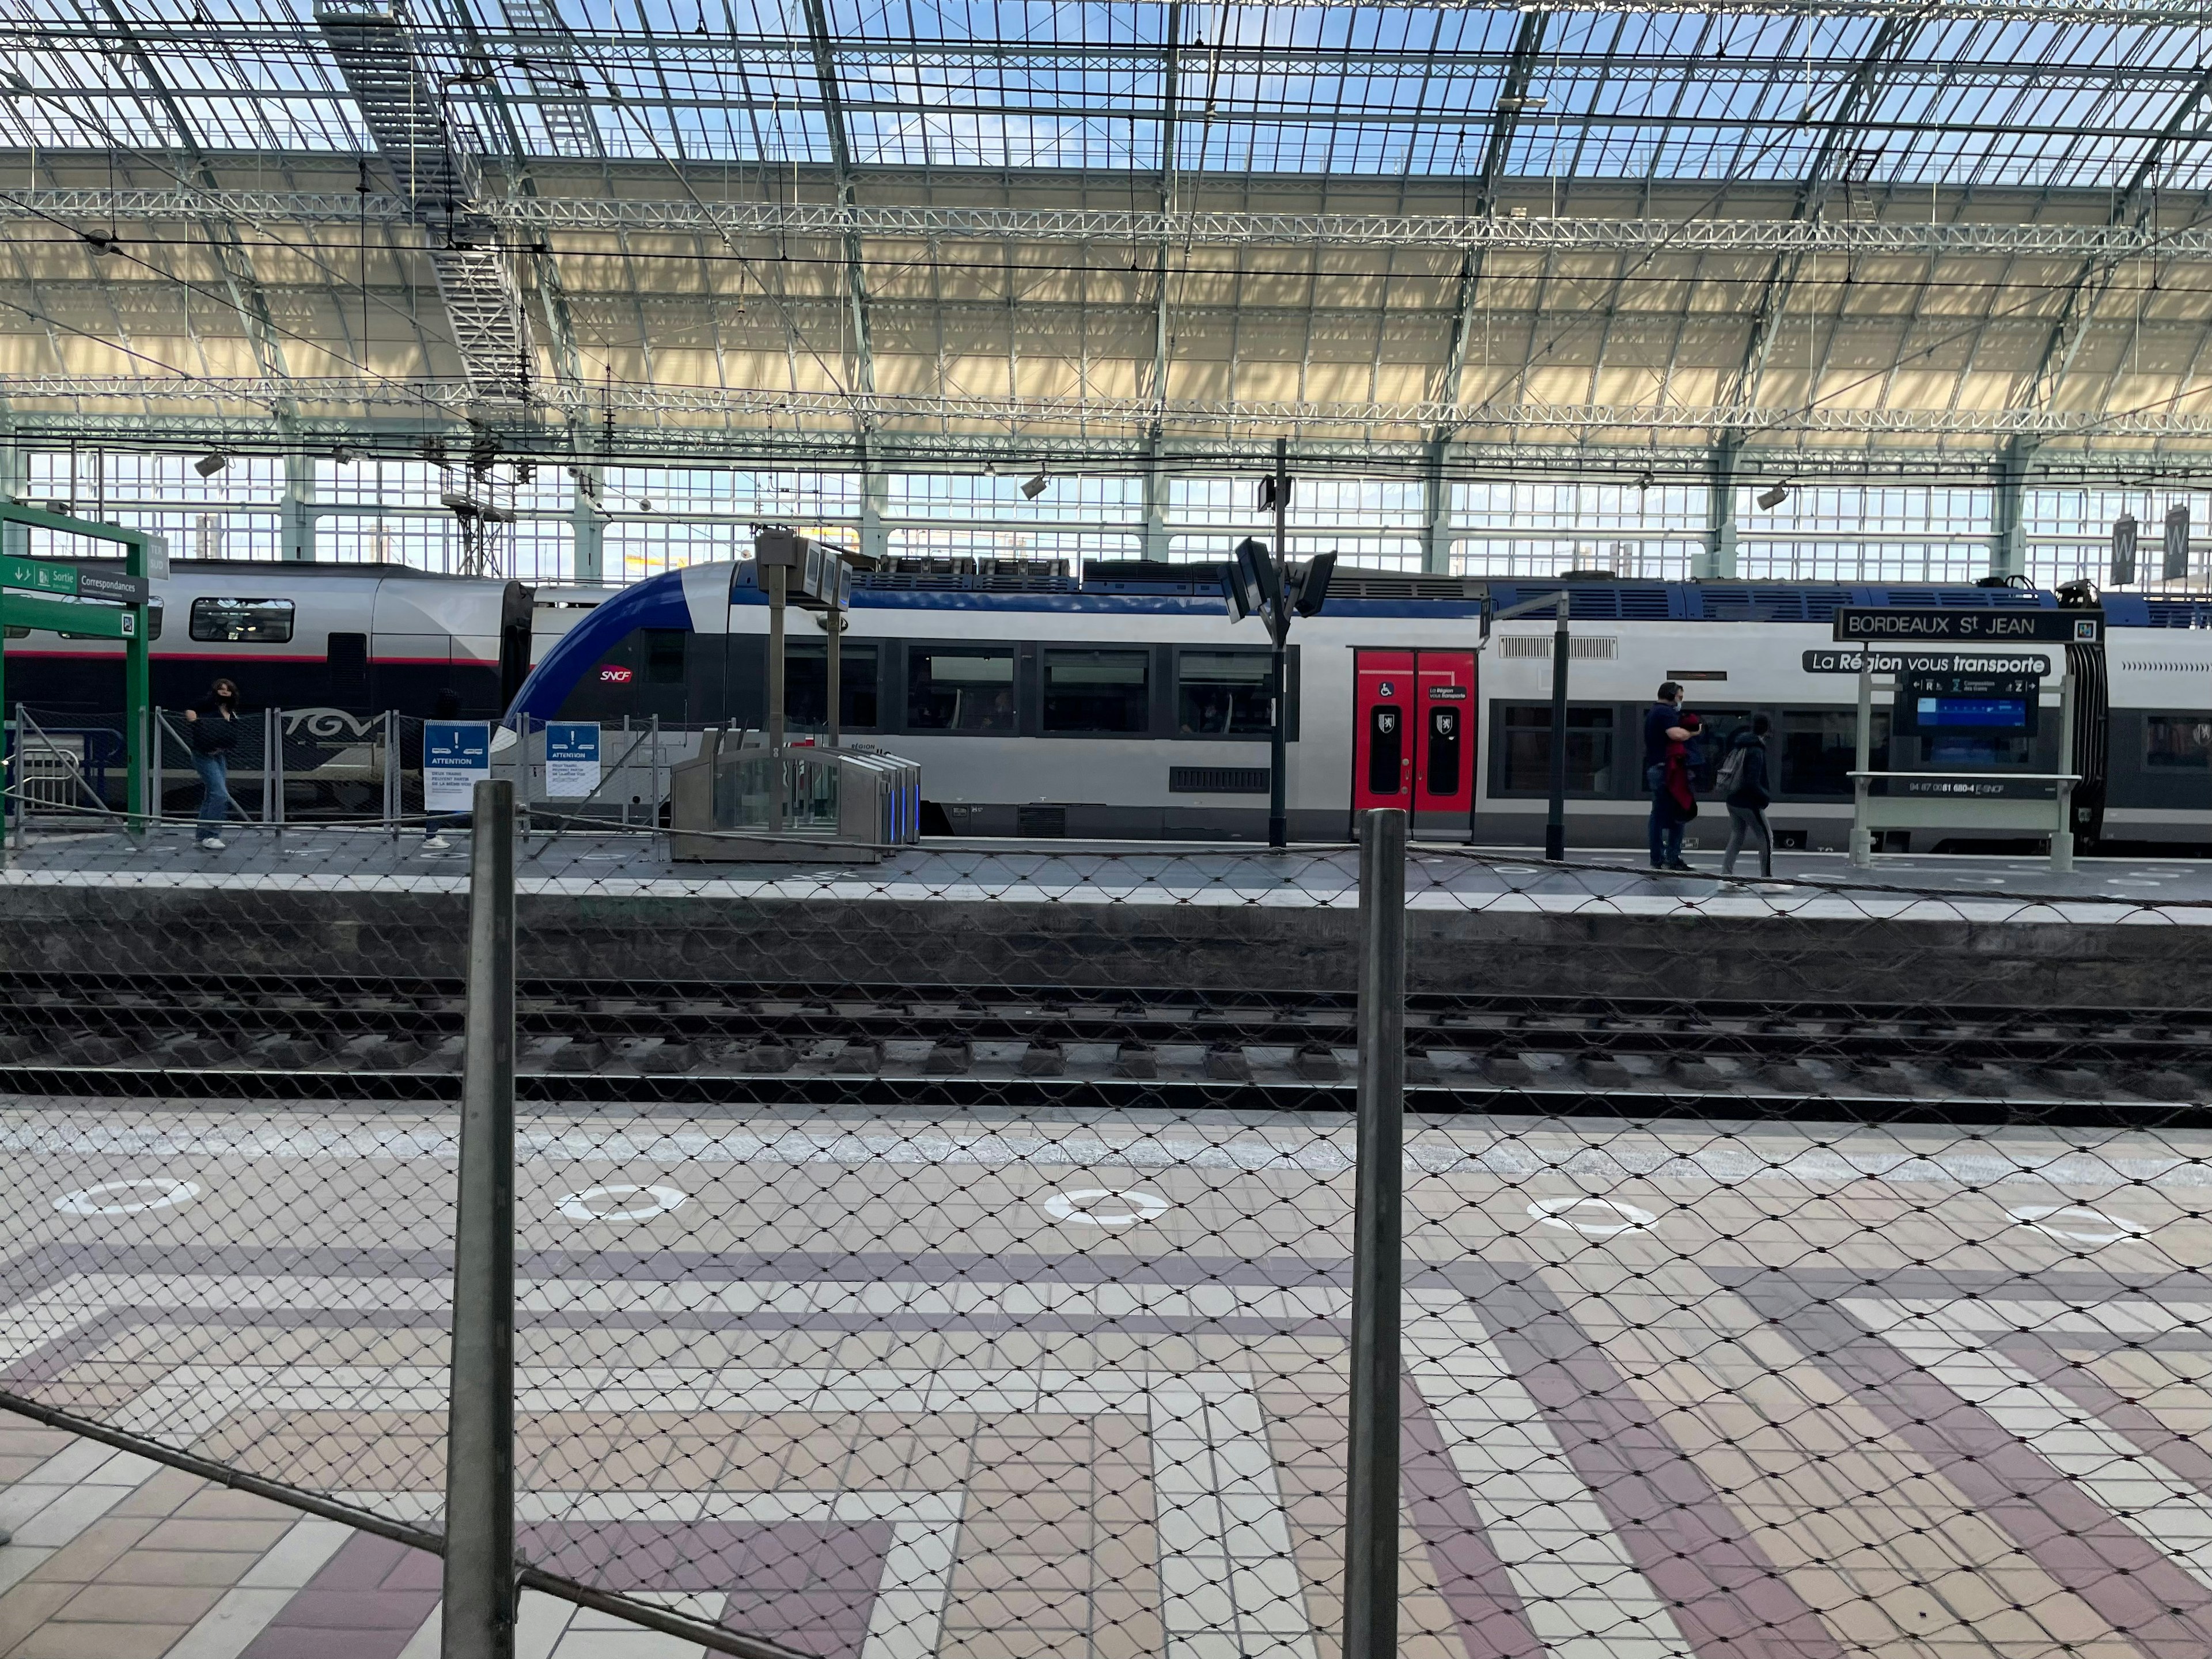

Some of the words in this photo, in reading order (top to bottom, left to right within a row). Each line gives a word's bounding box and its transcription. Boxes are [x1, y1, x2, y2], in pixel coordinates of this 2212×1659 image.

[2113, 533, 2135, 562] W
[2166, 523, 2187, 555] W
[150, 545, 162, 555] TER
[150, 560, 164, 570] SUD
[53, 570, 74, 583] Sortie
[81, 575, 136, 592] Correspondances
[1849, 616, 1949, 633] BORDEAUX
[1960, 616, 1978, 634] St
[1986, 618, 2035, 634] JEAN
[1813, 653, 1834, 669] La
[1839, 653, 1902, 673] Région
[1908, 658, 1949, 672] vous
[1953, 656, 2045, 674] transporte
[600, 671, 631, 680] SNCF
[281, 707, 387, 736] TGV
